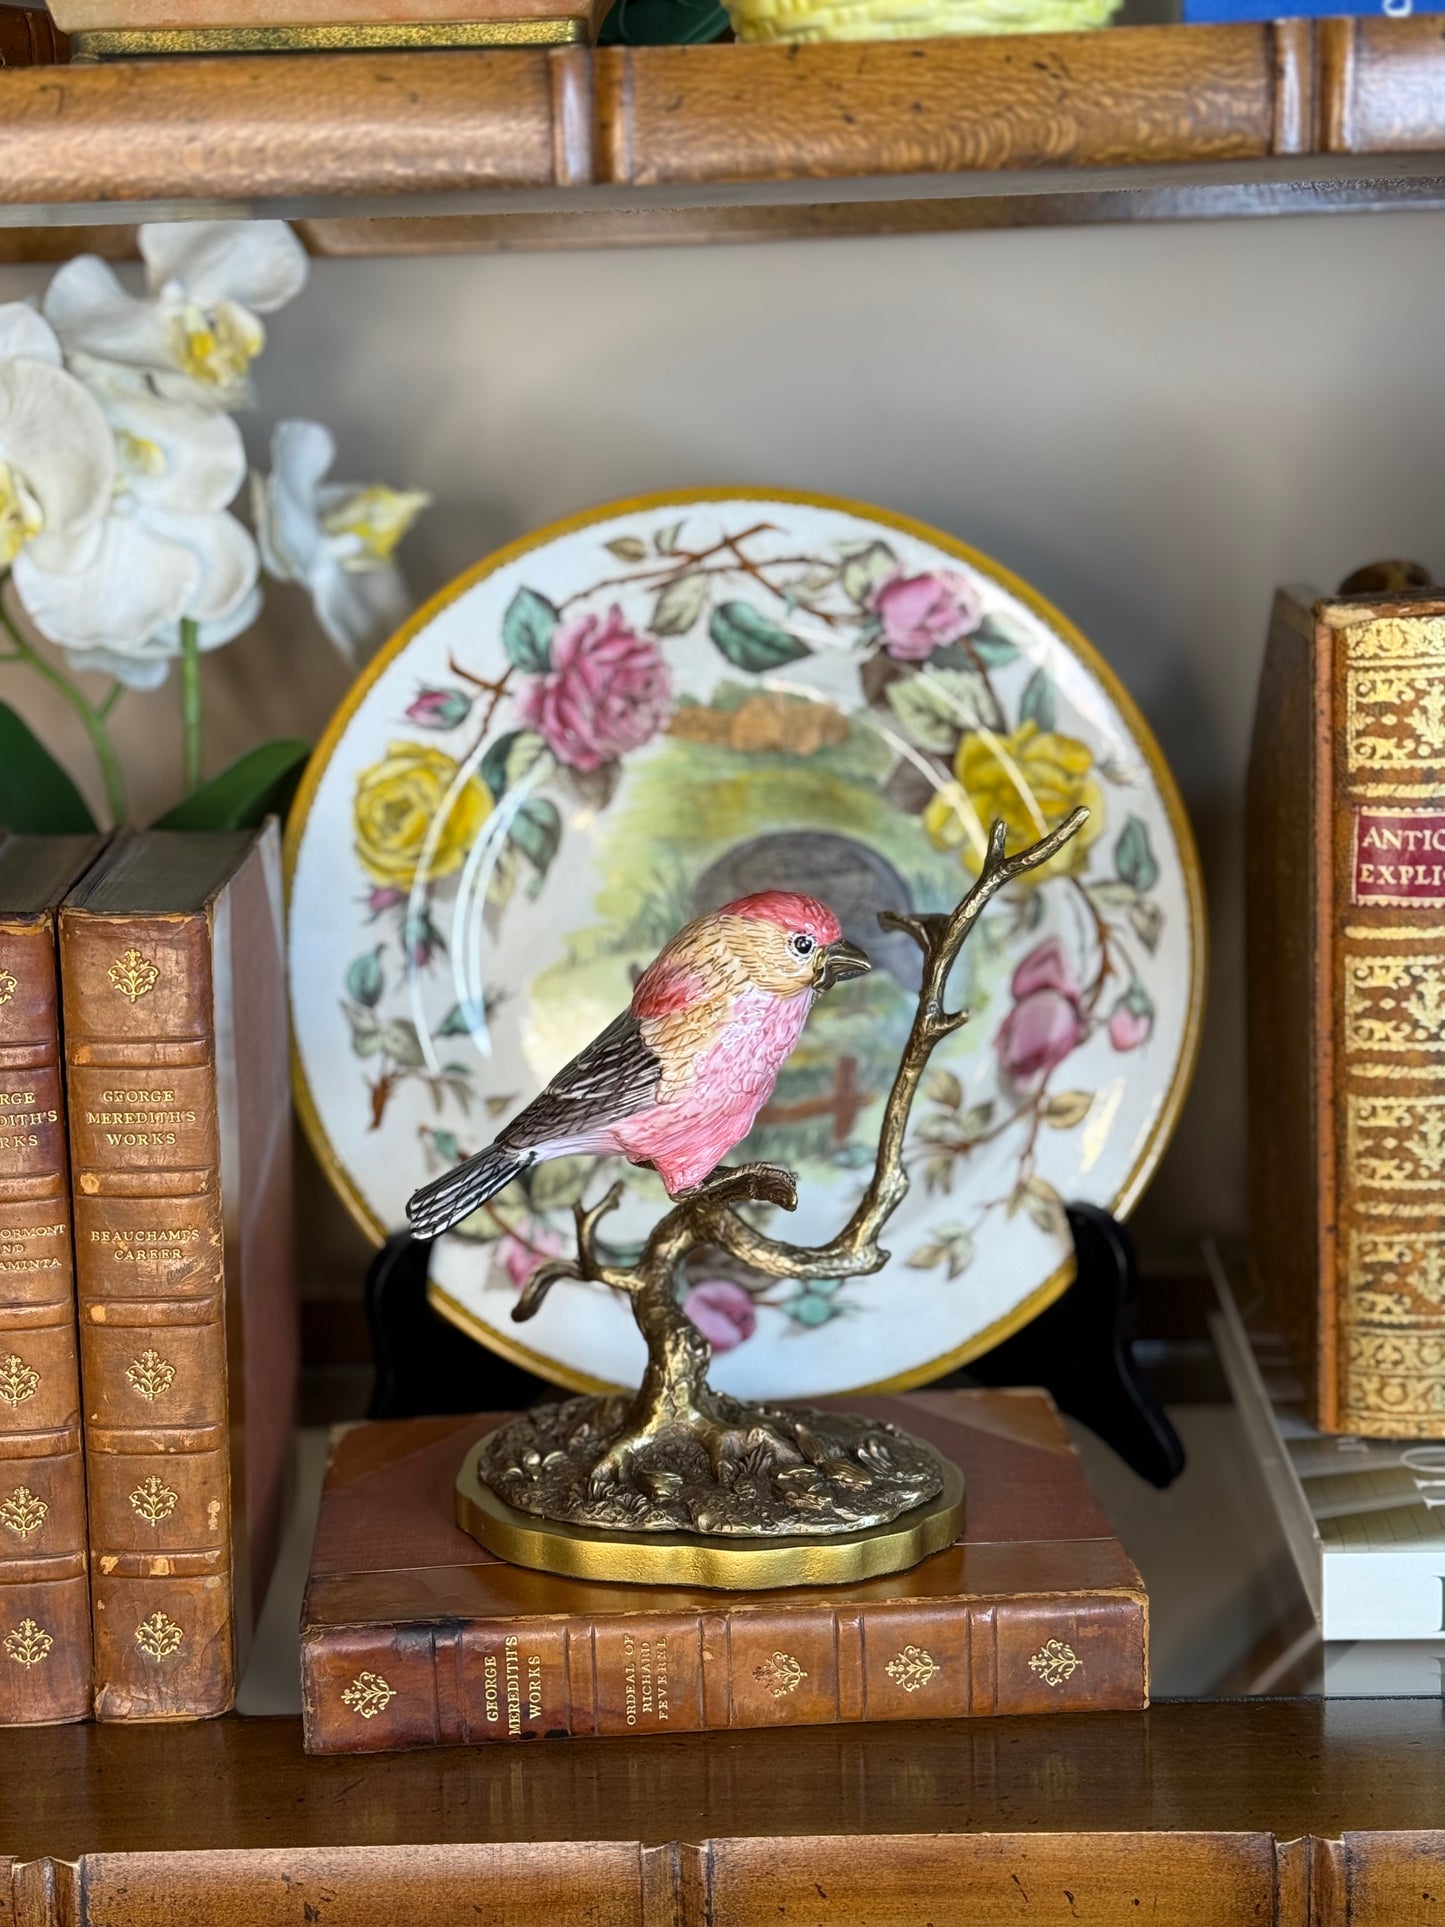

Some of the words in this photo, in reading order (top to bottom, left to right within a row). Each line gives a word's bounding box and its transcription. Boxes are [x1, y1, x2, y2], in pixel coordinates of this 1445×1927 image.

[87, 1110, 196, 1125] MEREDITH'S
[103, 1090, 175, 1103] GEORGE
[105, 1132, 177, 1146] WORKS
[114, 1248, 184, 1261] CAREER
[623, 1633, 635, 1656] OF
[484, 1655, 498, 1722] GEORGE
[505, 1634, 522, 1736] MEREDITH'S
[528, 1655, 543, 1720] WORKS
[624, 1662, 637, 1726] ORDEAL
[641, 1641, 653, 1713] RICHARD
[656, 1637, 669, 1721] FEVEREL
